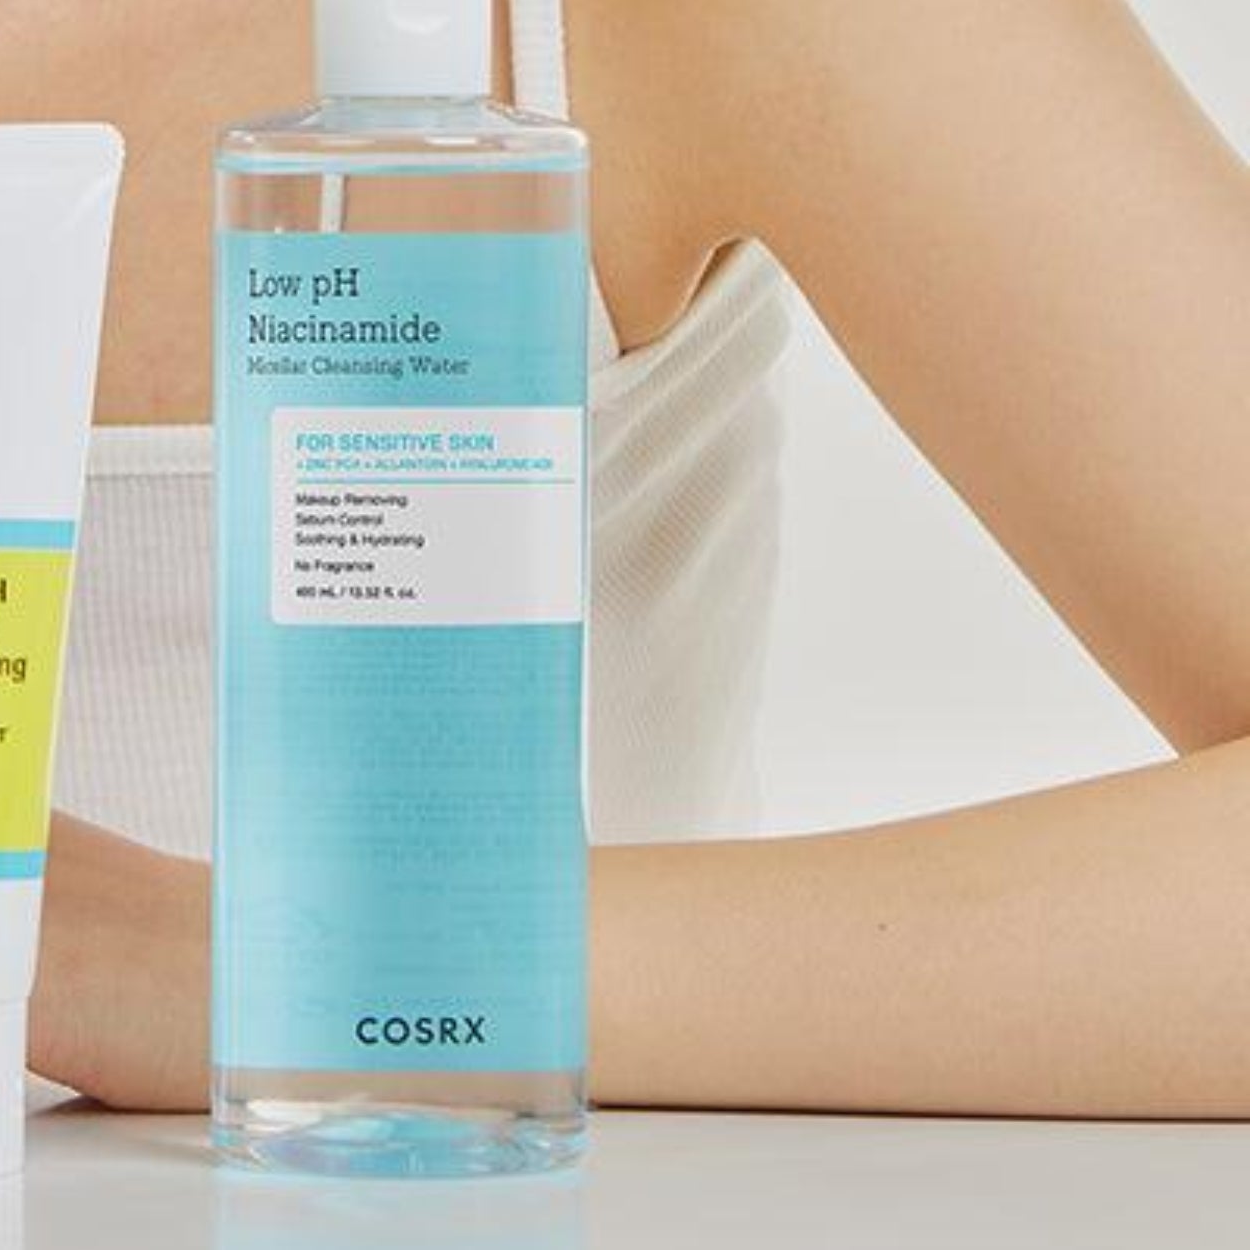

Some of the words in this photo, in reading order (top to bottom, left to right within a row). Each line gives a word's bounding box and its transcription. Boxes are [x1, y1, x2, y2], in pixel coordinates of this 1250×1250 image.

[249, 269, 300, 297] Low
[312, 268, 359, 303] pH
[249, 315, 441, 343] Niacinamide
[249, 357, 307, 375] Micellar
[312, 357, 404, 379] Cleansing
[410, 357, 470, 375] Water
[296, 435, 333, 450] FOR
[339, 434, 443, 450] SENSITIVE
[449, 434, 494, 450] SKIN
[296, 494, 341, 506] Makeup
[344, 494, 407, 507] Removing
[296, 513, 335, 525] Sebum
[339, 513, 383, 525] Control
[296, 533, 346, 547] Soothing
[350, 534, 358, 545] &
[363, 535, 425, 548] Hydrating
[295, 561, 310, 571] No
[315, 560, 375, 573] Fragrance
[356, 1017, 487, 1044] COSRX
